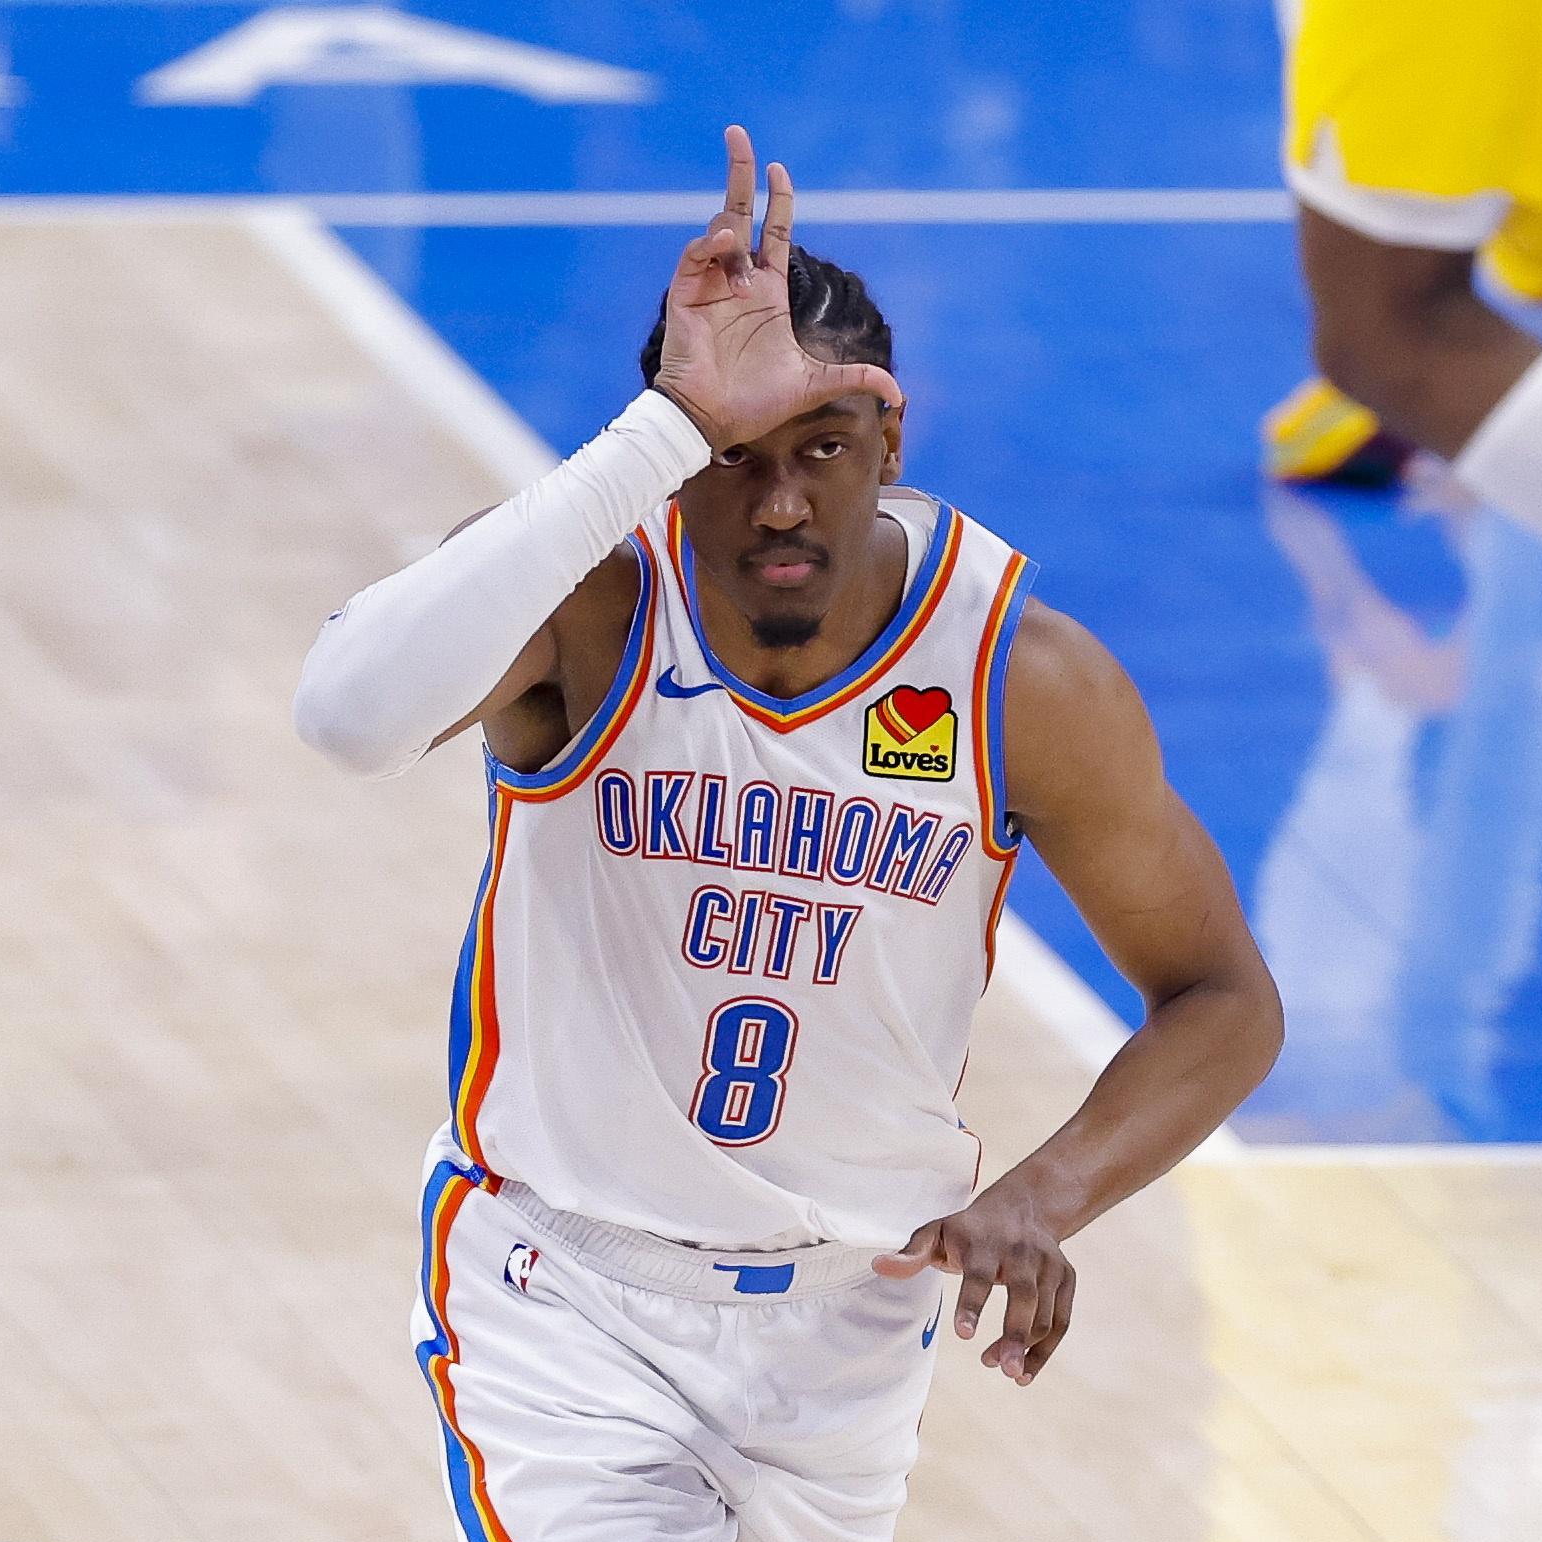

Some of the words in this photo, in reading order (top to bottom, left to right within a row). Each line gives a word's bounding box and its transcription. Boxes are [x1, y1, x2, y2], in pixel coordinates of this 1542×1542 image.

[594, 768, 974, 906] OKLAHOMA
[681, 884, 864, 985] CITY
[687, 995, 799, 1148] 8
